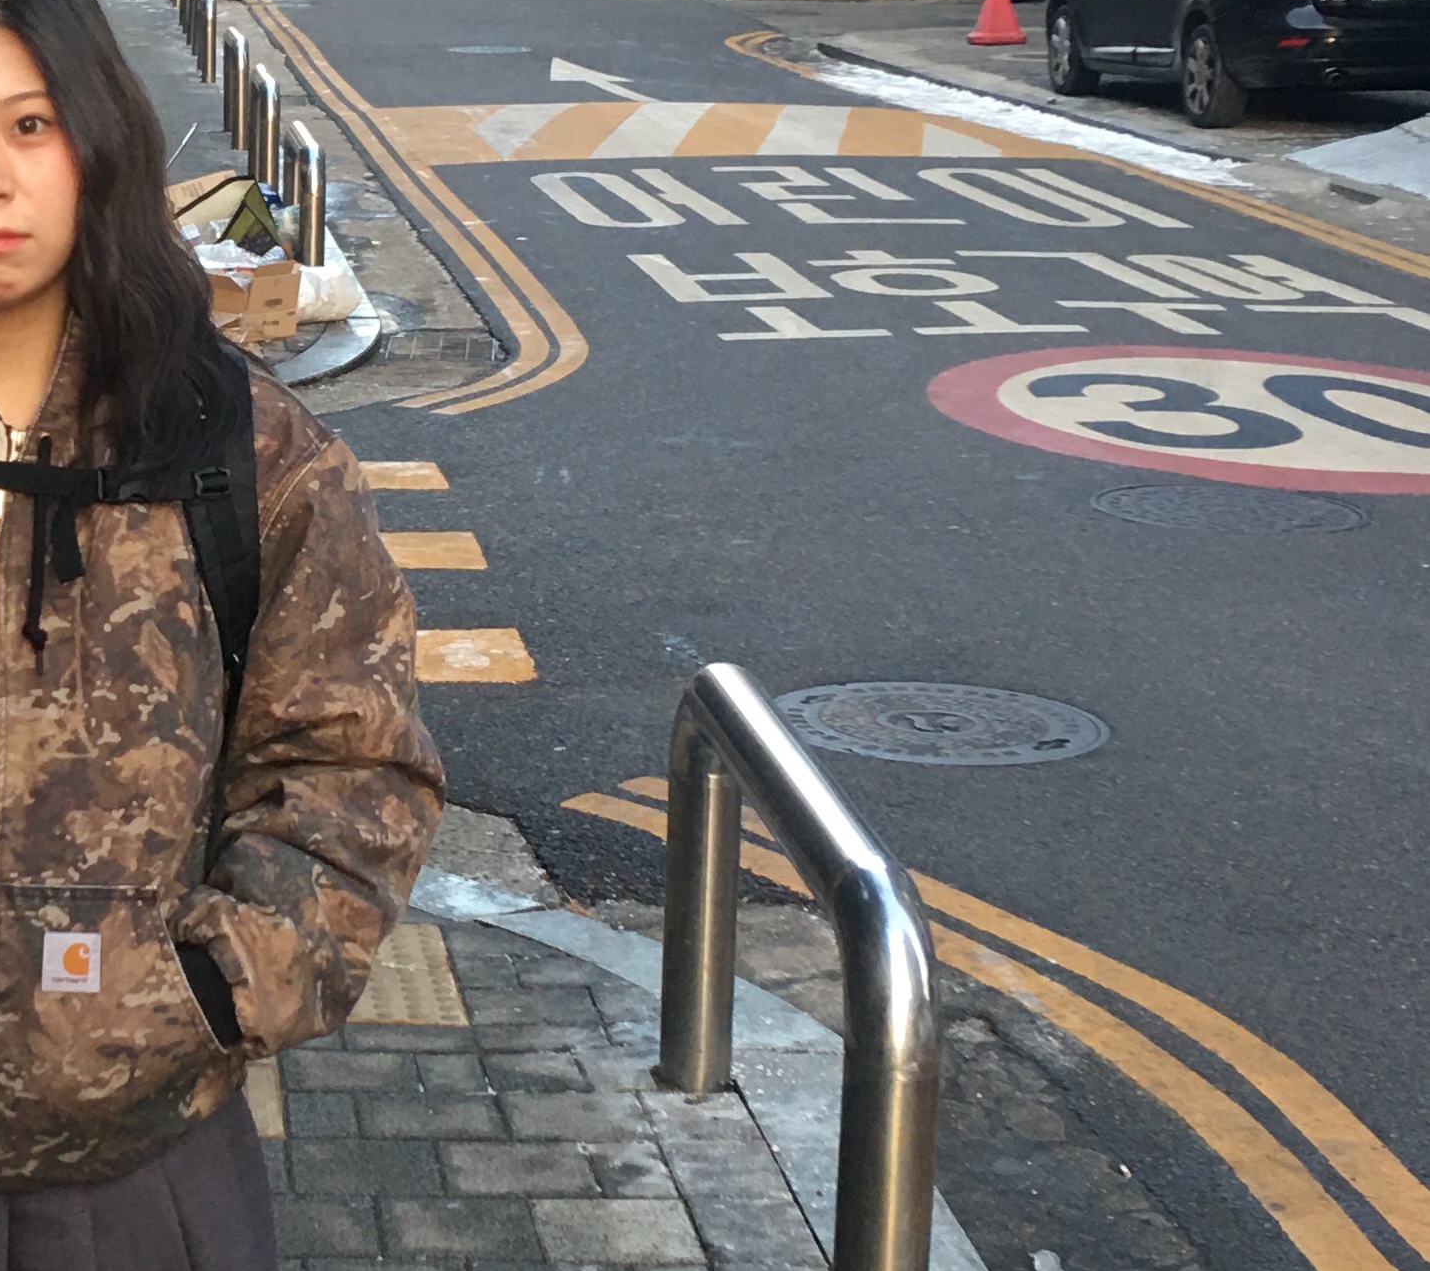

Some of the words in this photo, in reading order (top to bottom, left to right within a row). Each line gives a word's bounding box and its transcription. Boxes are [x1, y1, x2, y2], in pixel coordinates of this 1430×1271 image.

[530, 165, 1194, 228] 어린이
[626, 249, 1430, 341] 보호구역
[1028, 373, 1430, 450] 30
